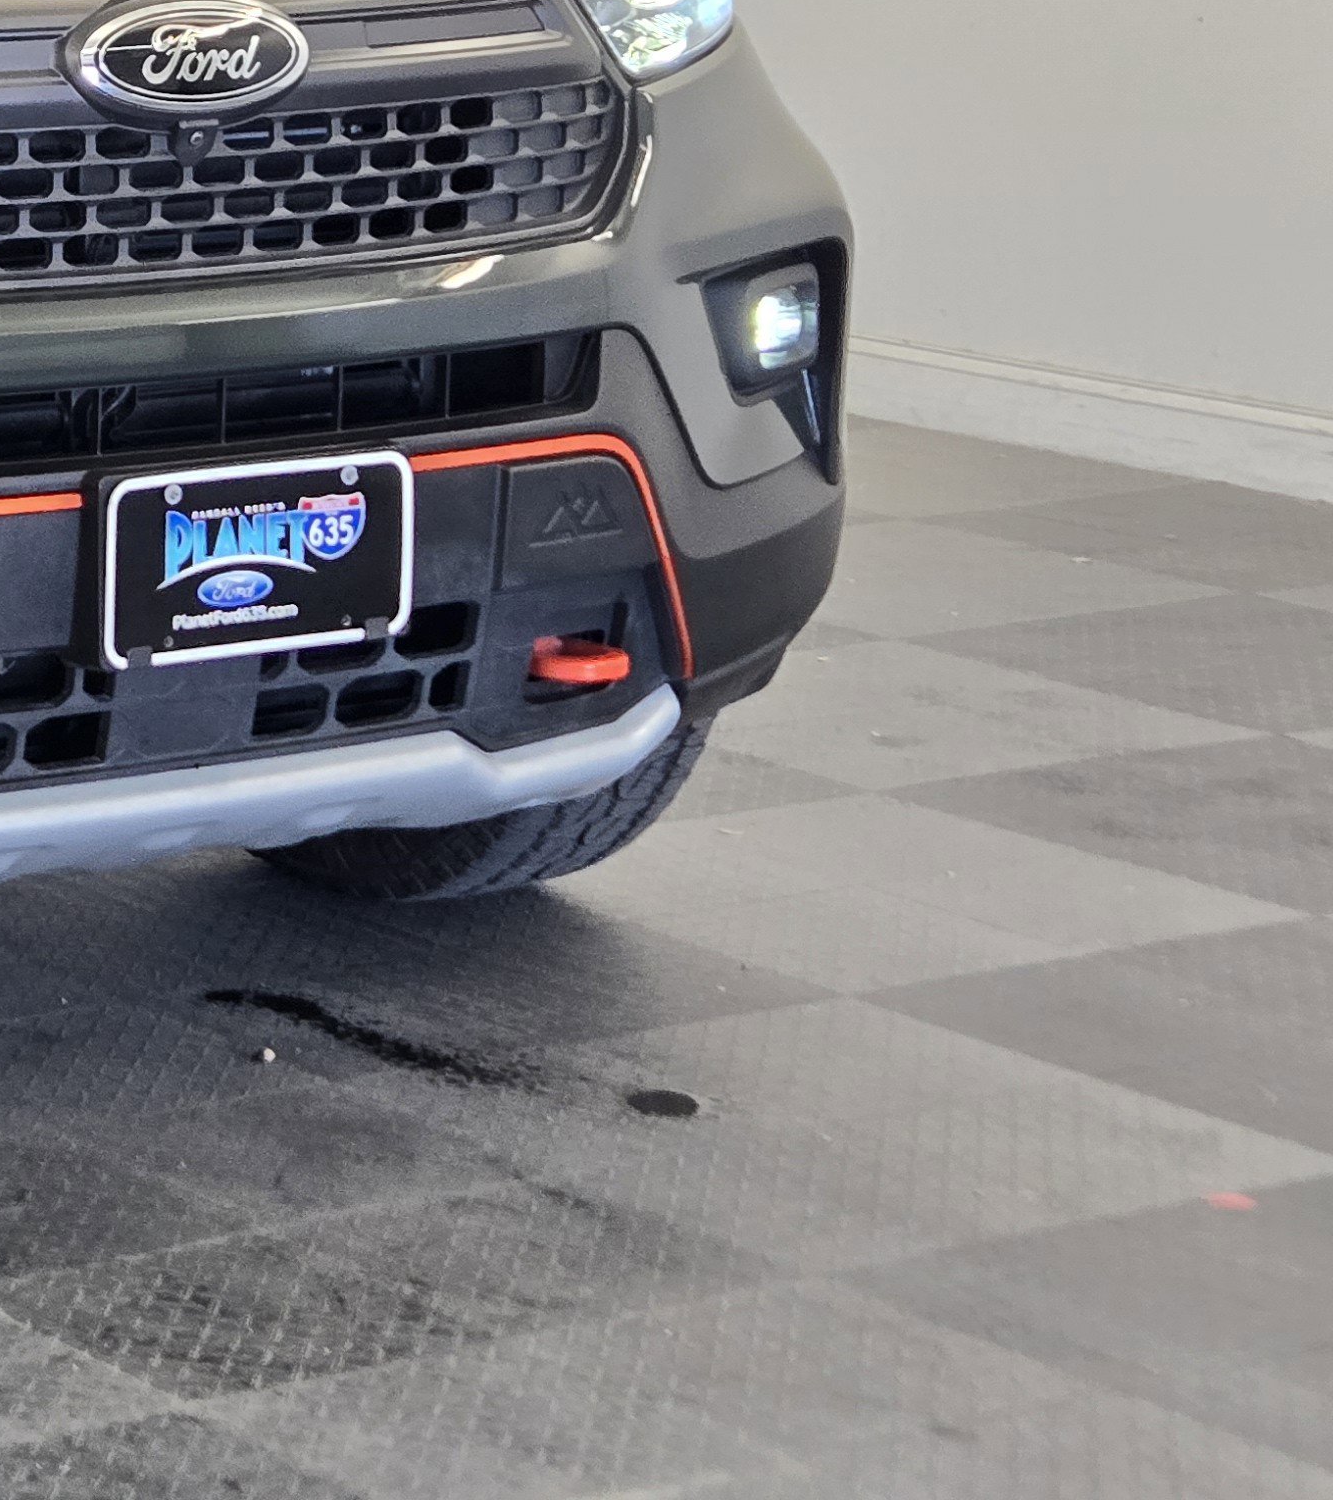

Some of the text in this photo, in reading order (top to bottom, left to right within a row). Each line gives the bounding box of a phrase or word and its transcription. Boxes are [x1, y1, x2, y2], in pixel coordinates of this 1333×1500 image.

[142, 20, 261, 85] Ford
[165, 509, 308, 581] PLANET
[309, 515, 354, 547] 635
[212, 580, 257, 601] Ford
